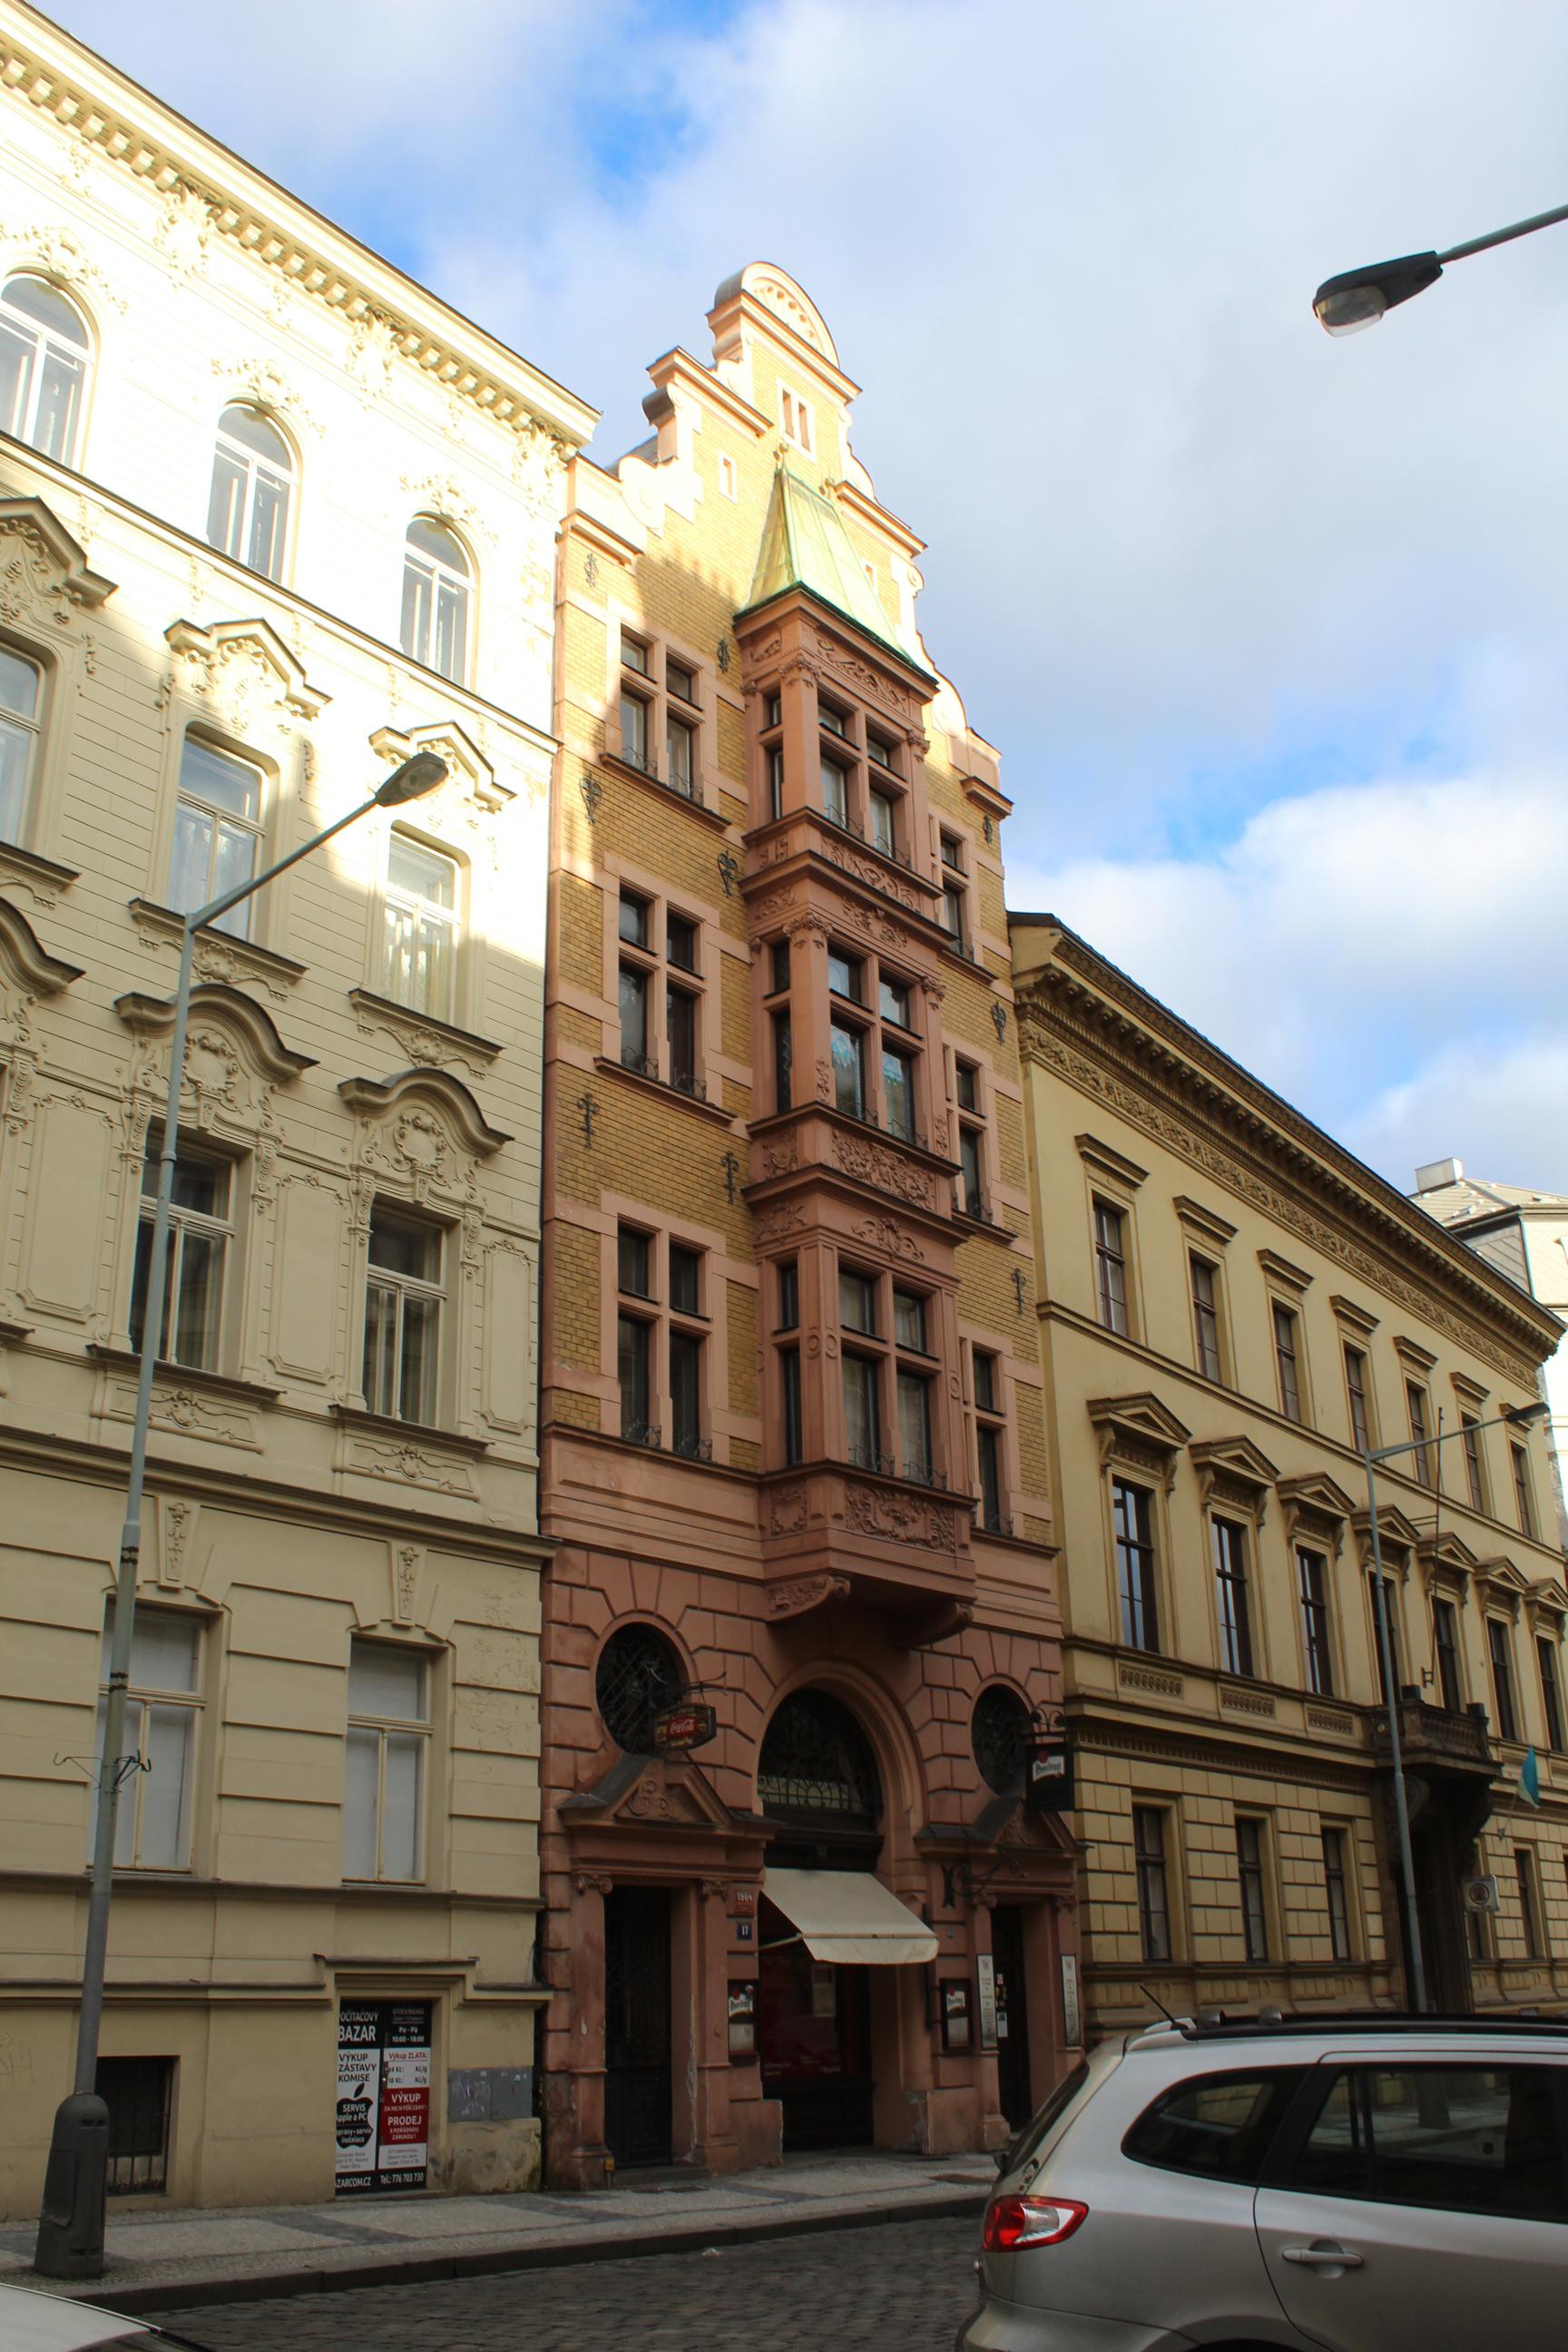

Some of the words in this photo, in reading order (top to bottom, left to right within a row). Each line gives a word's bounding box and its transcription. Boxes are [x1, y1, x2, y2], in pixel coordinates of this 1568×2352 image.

[741, 1924, 749, 1936] 17
[338, 2024, 377, 2042] BAZAR
[338, 2052, 368, 2062] VÝKUP
[388, 2052, 407, 2061] Výkup
[338, 2073, 370, 2082] KOMISE
[391, 2092, 421, 2103] VÝKUP
[342, 2103, 366, 2112] SERVIS
[358, 2112, 368, 2121] PC
[387, 2115, 422, 2126] PRODEJ
[392, 2172, 403, 2183] 776
